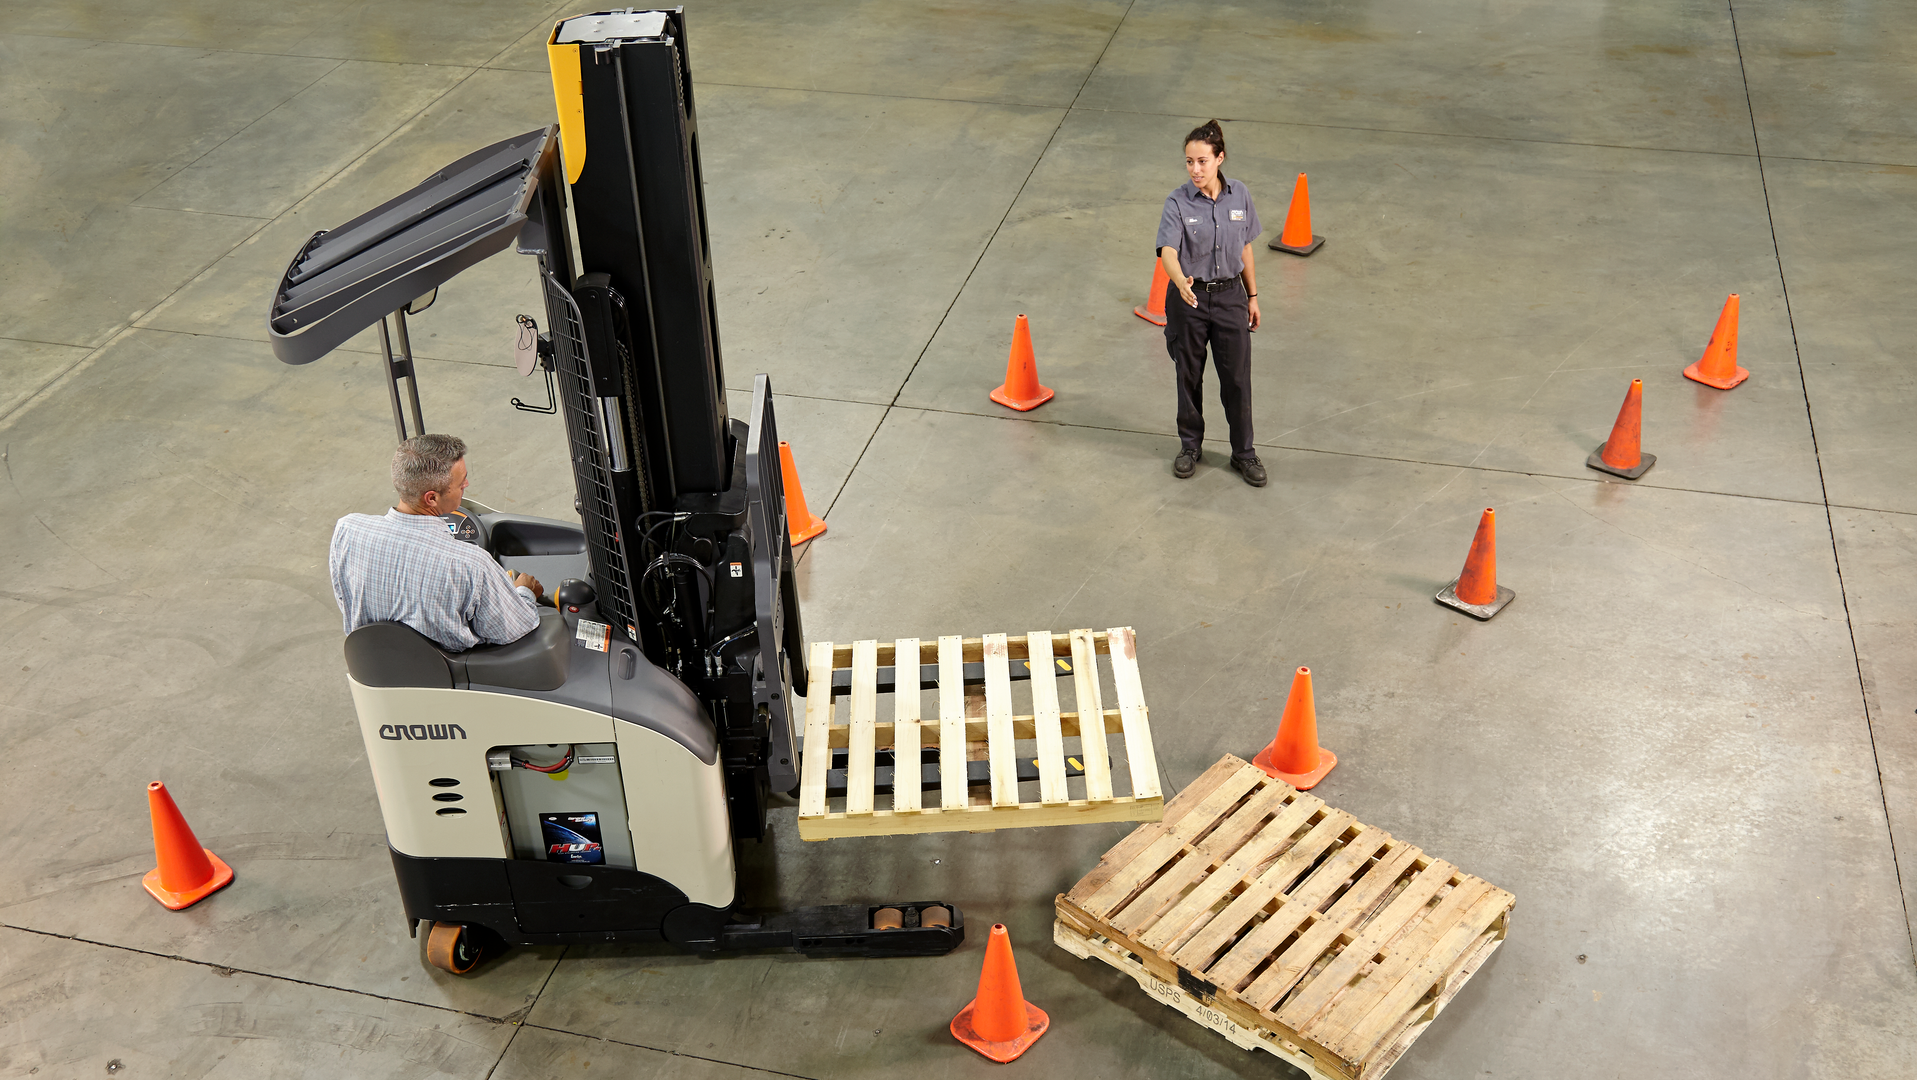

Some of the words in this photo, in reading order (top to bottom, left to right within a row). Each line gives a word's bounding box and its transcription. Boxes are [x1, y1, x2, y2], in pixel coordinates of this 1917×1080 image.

[379, 724, 467, 740] CROWN
[1150, 978, 1181, 1004] USPS
[1195, 1005, 1236, 1034] 4/03/14
